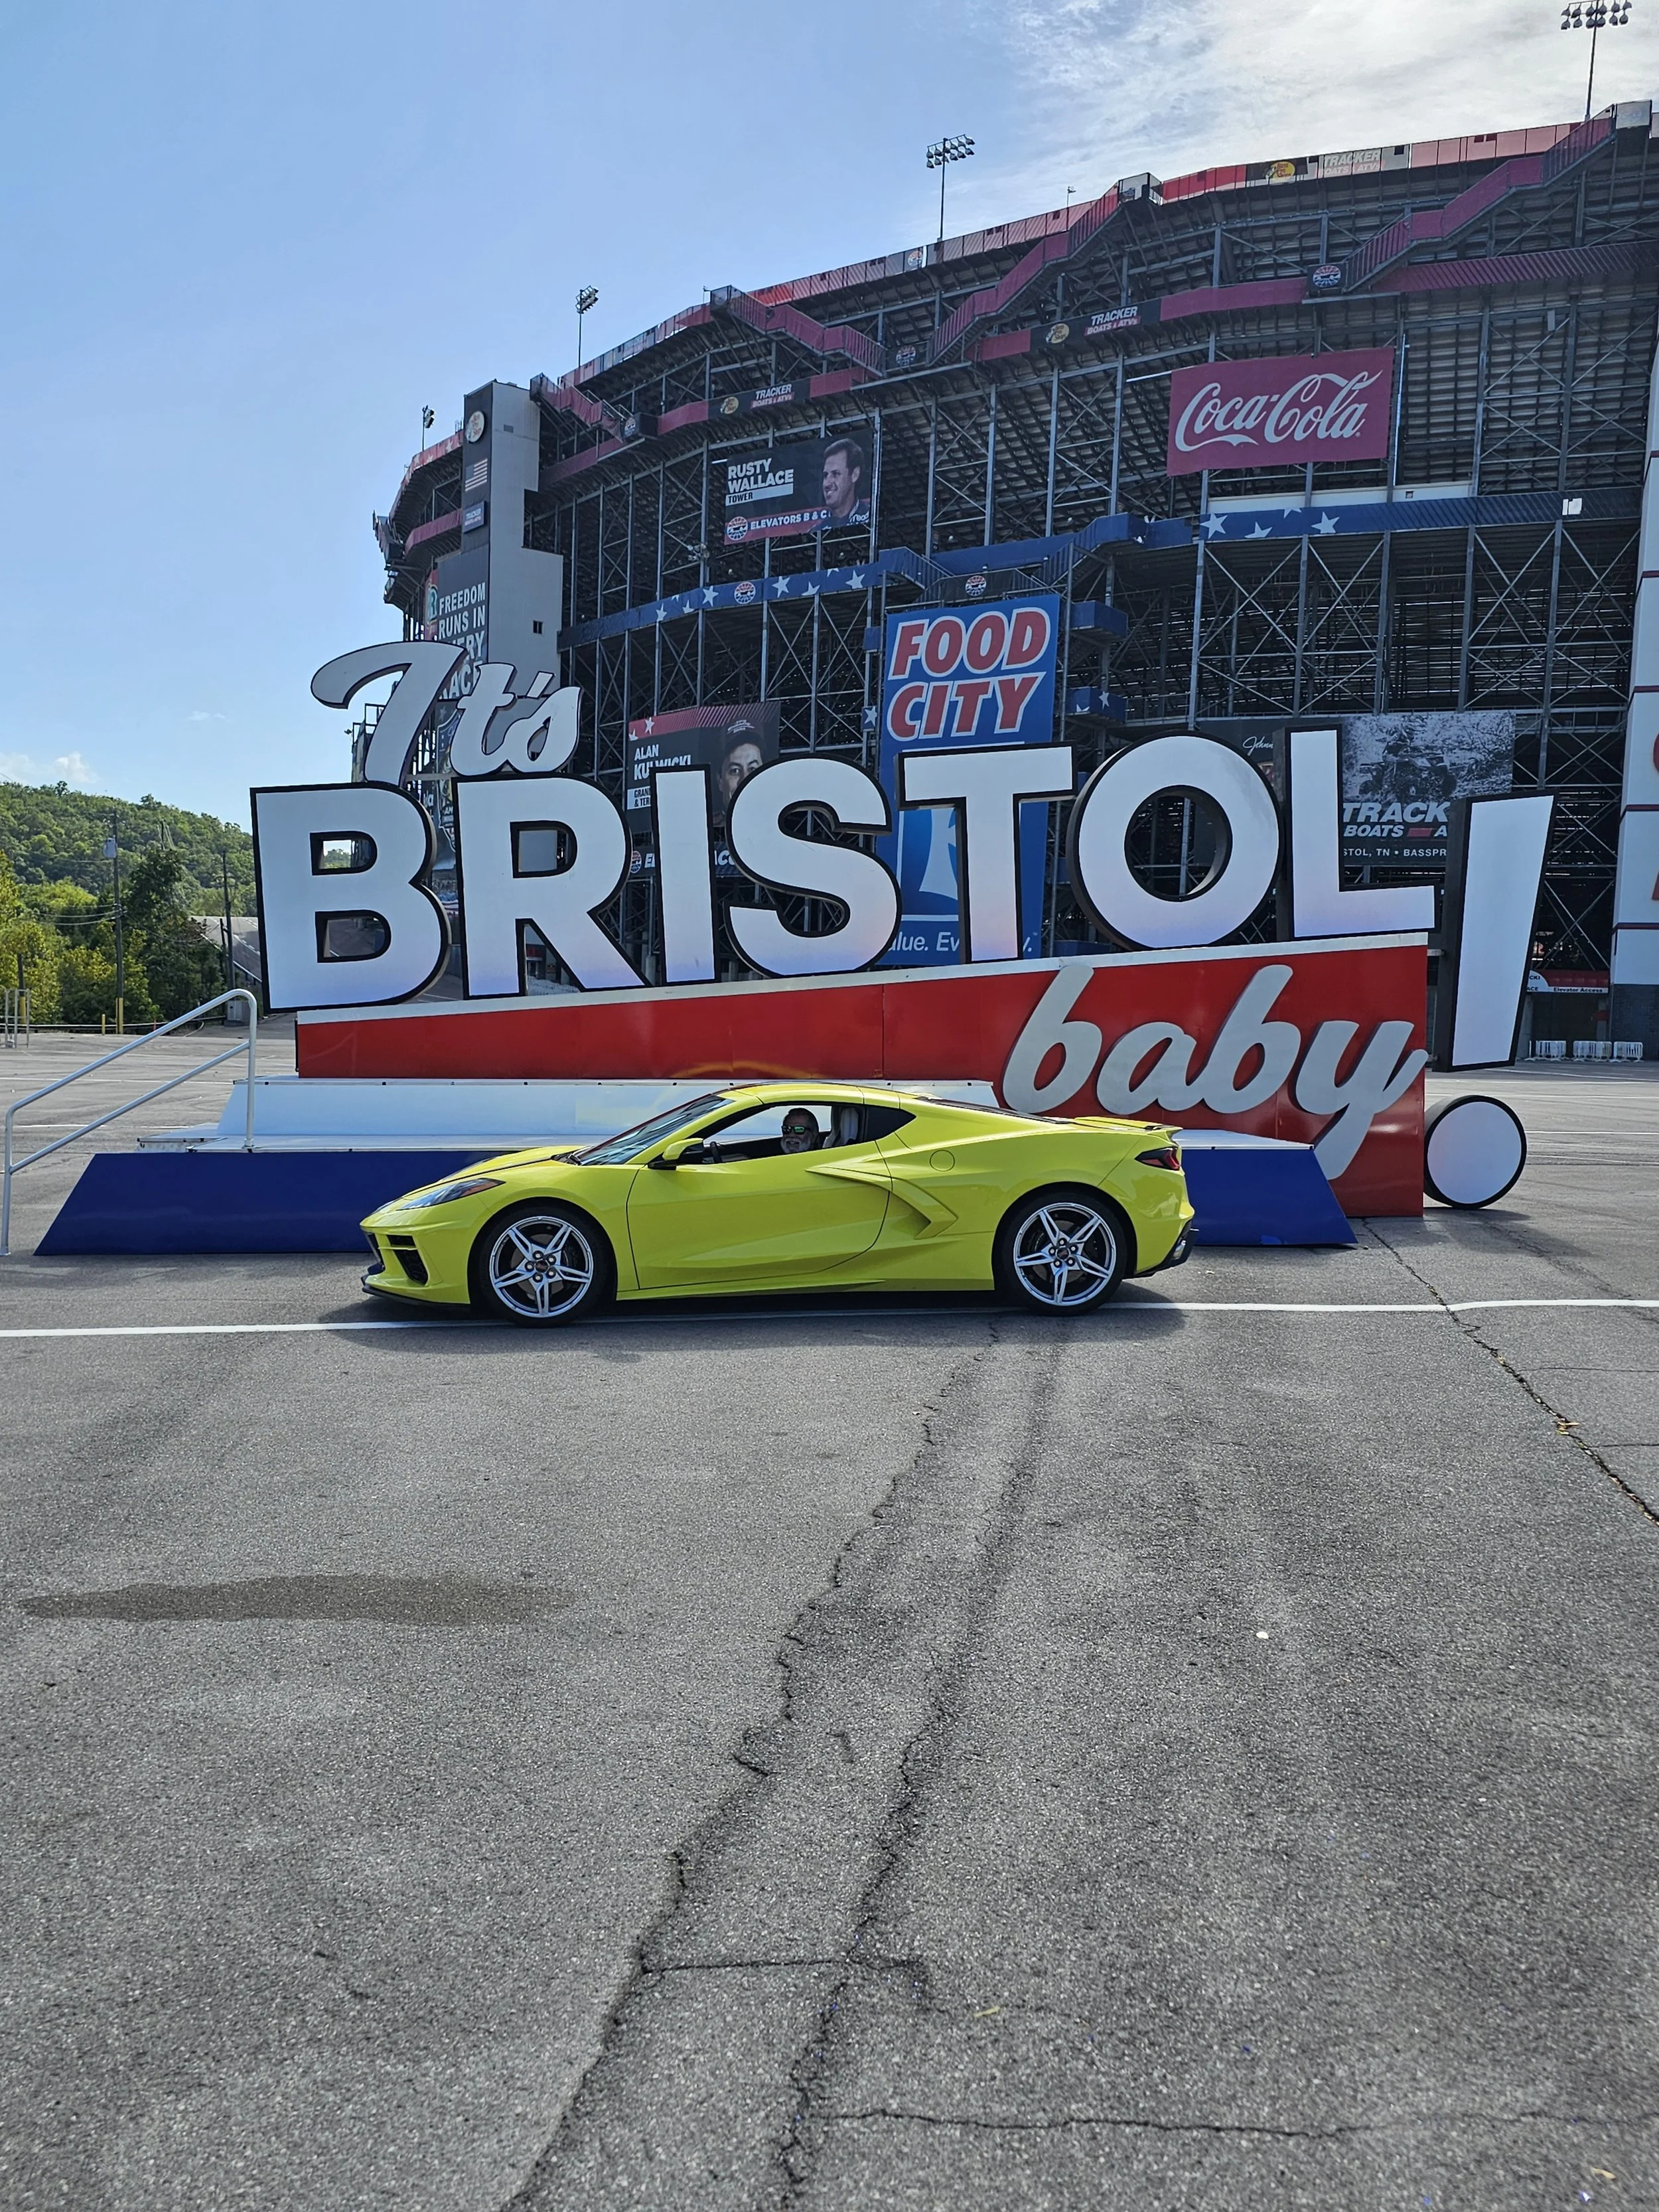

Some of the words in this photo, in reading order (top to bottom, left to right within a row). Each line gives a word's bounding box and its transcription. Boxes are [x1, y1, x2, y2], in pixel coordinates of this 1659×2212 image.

[1325, 151, 1380, 167] TRACKER
[1091, 306, 1138, 326] TRACKER
[1087, 322, 1112, 335] BOATS
[1118, 318, 1137, 327] ATVs
[756, 384, 792, 400] TRACKER
[753, 398, 772, 408] BOATS
[1175, 369, 1384, 452] Coca-Cola
[727, 458, 772, 480] RUSTY
[727, 469, 794, 494] WALLACE
[728, 492, 753, 504] TOWER
[750, 514, 802, 530] ELEVATORS
[803, 512, 810, 522] B
[812, 511, 818, 520] &
[820, 510, 828, 518] C
[439, 582, 486, 617] FREEDOM
[439, 611, 469, 640] RUNS
[473, 605, 485, 629] IN
[887, 607, 1051, 681] FOOD
[311, 640, 583, 784] It's
[887, 671, 1047, 742] CITY
[634, 743, 659, 761] ALAN
[1342, 802, 1451, 823] TRACK
[1343, 824, 1405, 838] BOATS
[1343, 848, 1372, 857] STOL,
[250, 727, 1437, 1013] BRISTOL
